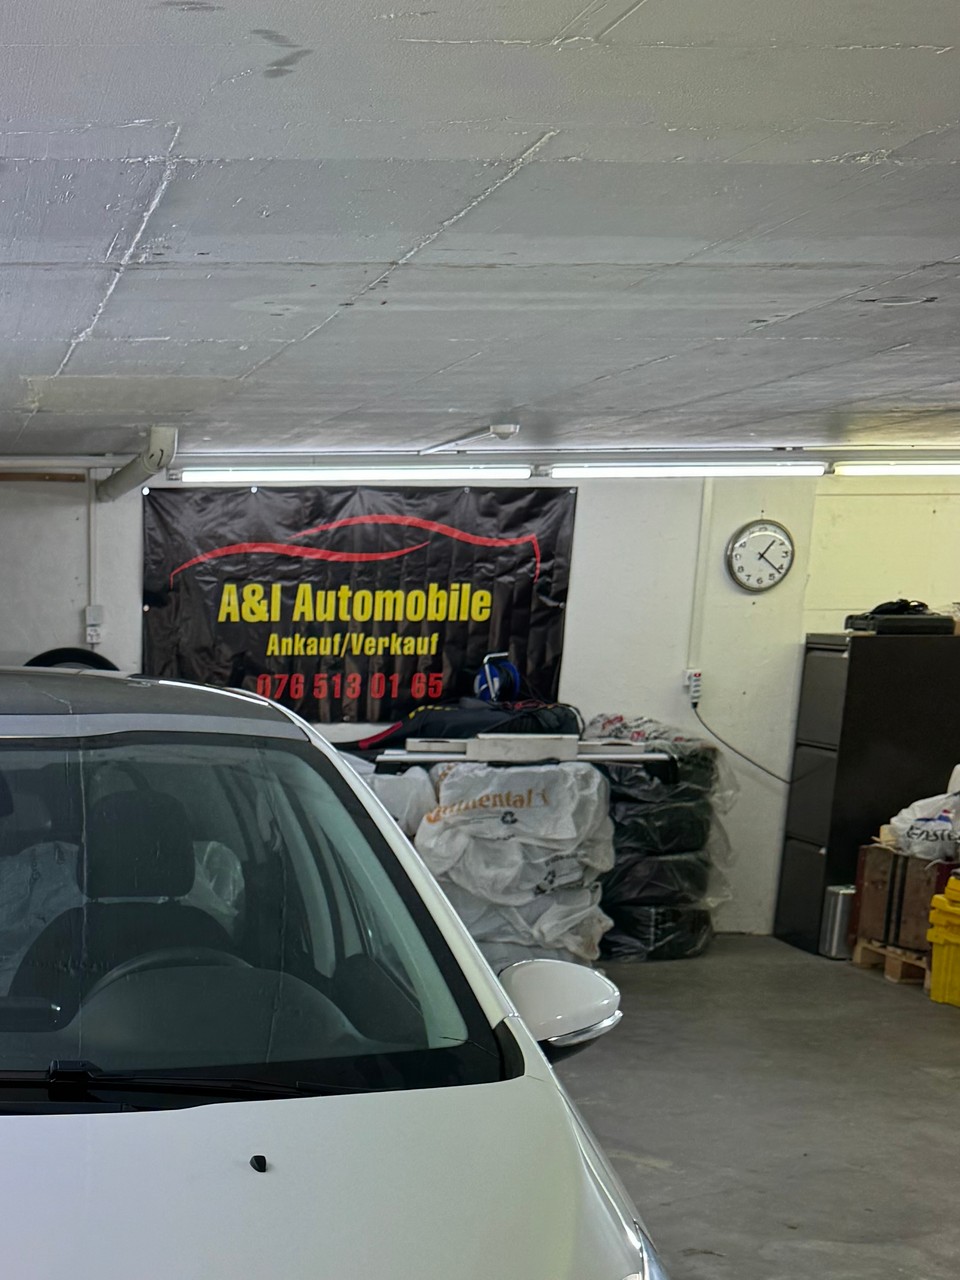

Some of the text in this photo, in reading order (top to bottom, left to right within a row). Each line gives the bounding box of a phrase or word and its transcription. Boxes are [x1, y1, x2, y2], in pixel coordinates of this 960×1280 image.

[218, 583, 492, 622] A&I Automobile
[266, 632, 439, 657] Ankauf/Verkauf
[256, 672, 443, 699] 076 513 01 65
